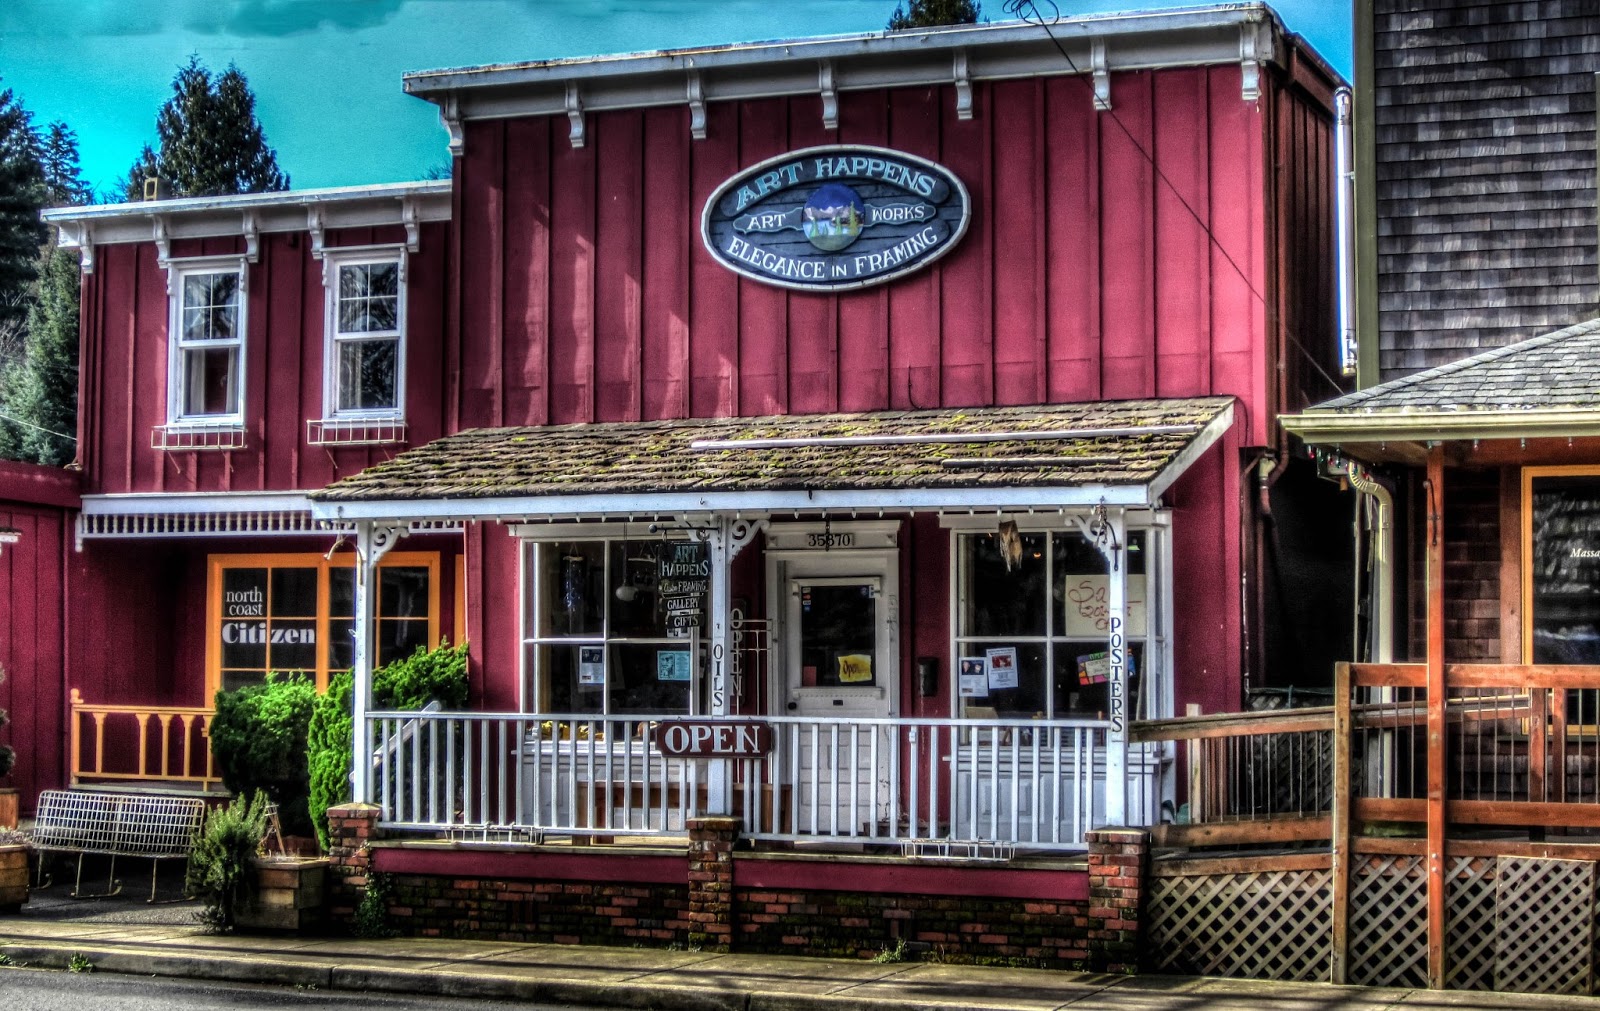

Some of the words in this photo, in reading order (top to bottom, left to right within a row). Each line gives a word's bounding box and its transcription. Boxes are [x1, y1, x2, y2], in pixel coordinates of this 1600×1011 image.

[736, 161, 803, 210] ART
[815, 157, 936, 196] HAPPENS
[747, 214, 787, 230] ART
[872, 205, 925, 221] WORKS
[727, 236, 825, 278] ELEGANCE
[831, 264, 847, 277] IN
[854, 226, 938, 275] FRAMING
[808, 533, 851, 547] 35870
[674, 545, 698, 563] ART
[1570, 548, 1600, 558] Massa
[661, 560, 709, 577] HAPPENS
[226, 586, 263, 602] north
[678, 580, 707, 592] FRAMING
[229, 603, 263, 616] coast
[667, 597, 700, 610] GALLERY
[674, 615, 699, 627] GIFTS
[222, 622, 315, 644] Citizen
[713, 644, 724, 707] OILS
[1110, 617, 1123, 733] POSTERS
[664, 725, 761, 754] OPEN
